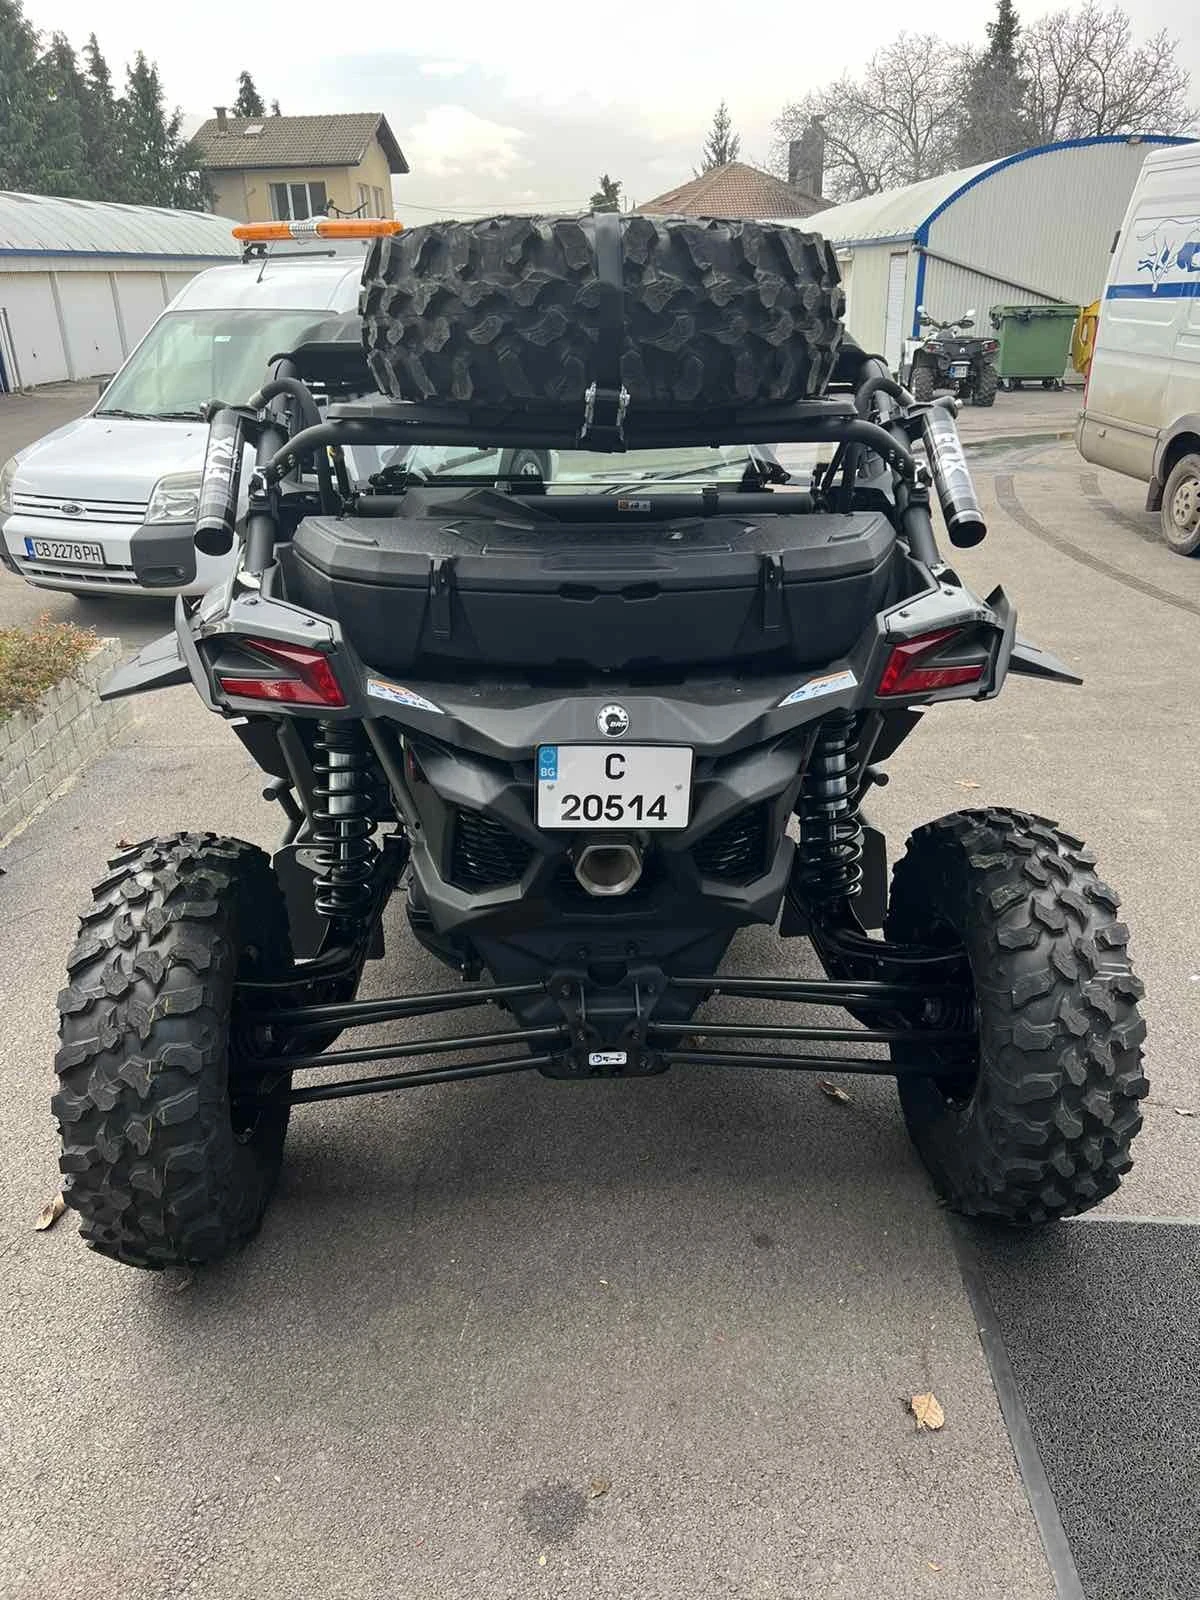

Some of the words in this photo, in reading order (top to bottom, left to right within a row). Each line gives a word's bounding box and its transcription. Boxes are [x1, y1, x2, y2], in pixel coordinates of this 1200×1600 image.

[35, 541, 52, 558] CB
[52, 543, 83, 560] 2278
[83, 545, 101, 562] PH
[540, 767, 556, 778] BG
[605, 753, 626, 780] C
[560, 794, 668, 822] 20514
